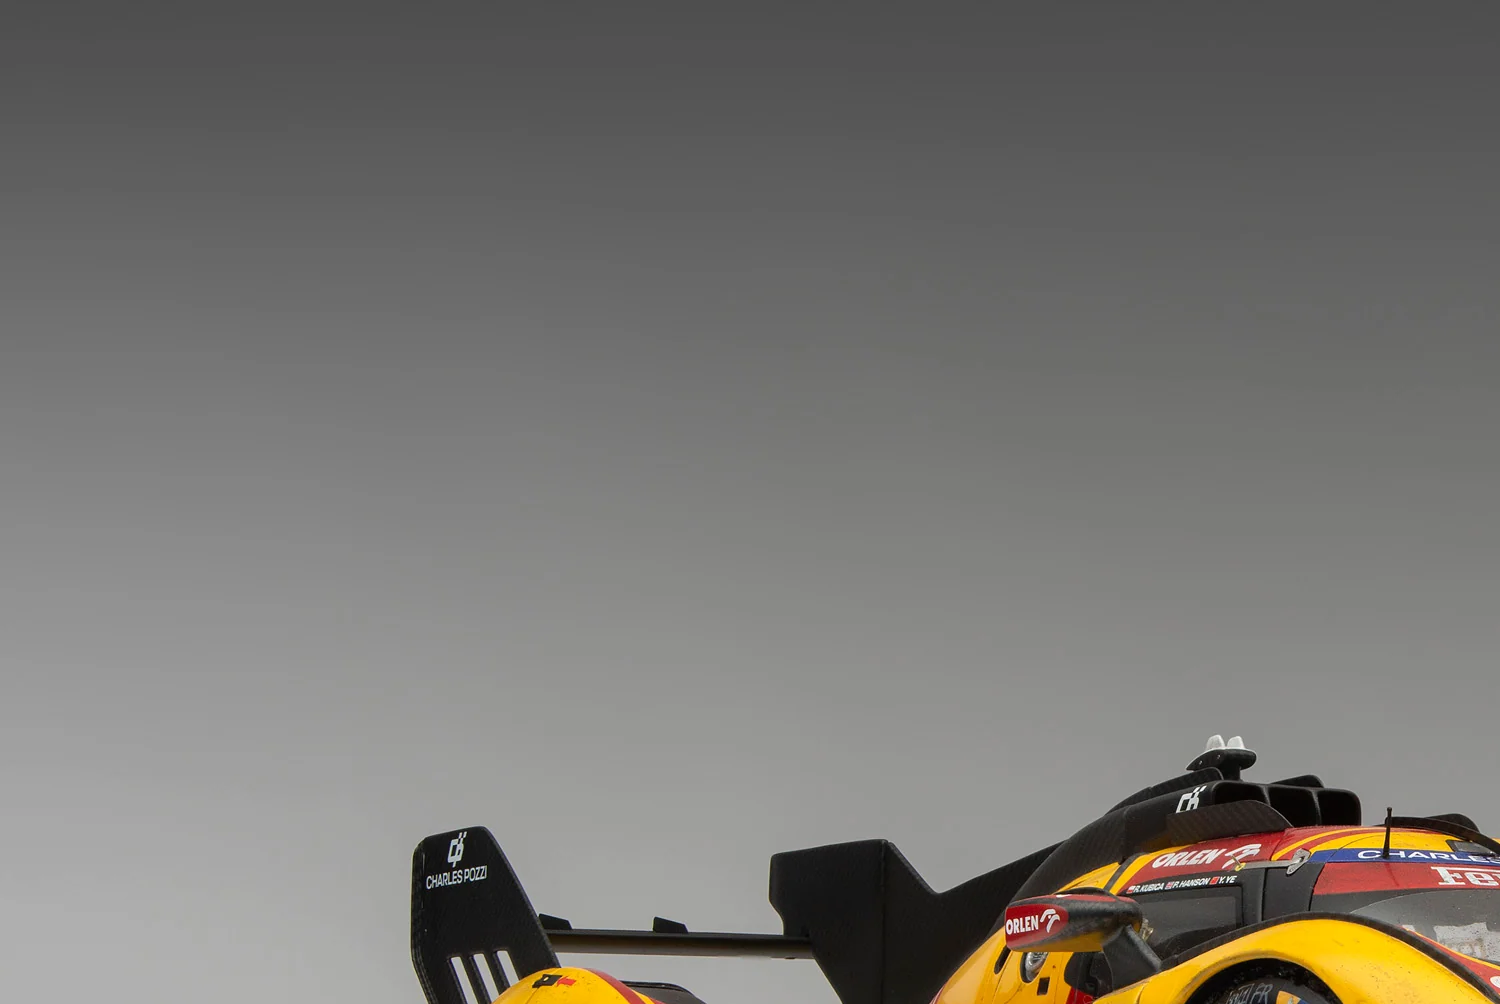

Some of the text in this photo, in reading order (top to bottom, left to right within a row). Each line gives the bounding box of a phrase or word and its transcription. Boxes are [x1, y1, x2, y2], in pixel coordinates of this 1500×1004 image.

[1151, 848, 1228, 869] ORLEN
[426, 865, 488, 889] CHARLES POZZI
[1005, 914, 1039, 935] ORLEN
